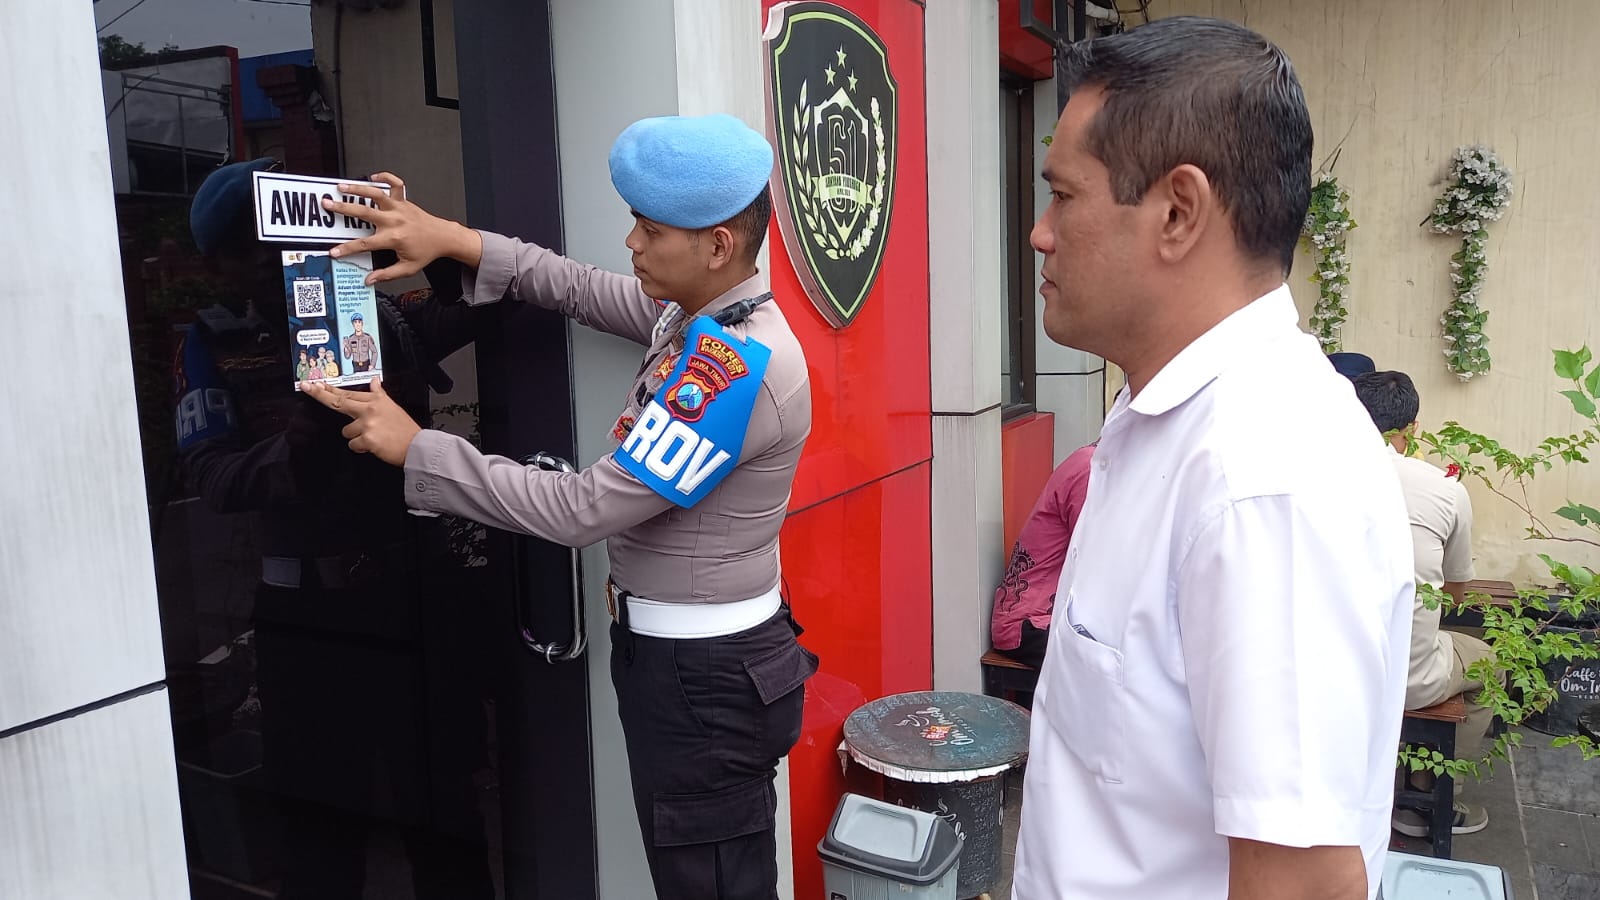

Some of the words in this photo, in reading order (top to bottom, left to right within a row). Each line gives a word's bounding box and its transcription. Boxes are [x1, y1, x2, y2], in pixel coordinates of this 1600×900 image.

[271, 190, 336, 228] AWAS
[702, 338, 744, 373] POLRES
[692, 359, 709, 371] JAWA
[710, 369, 726, 388] TIMUR
[1560, 678, 1588, 692] Om
